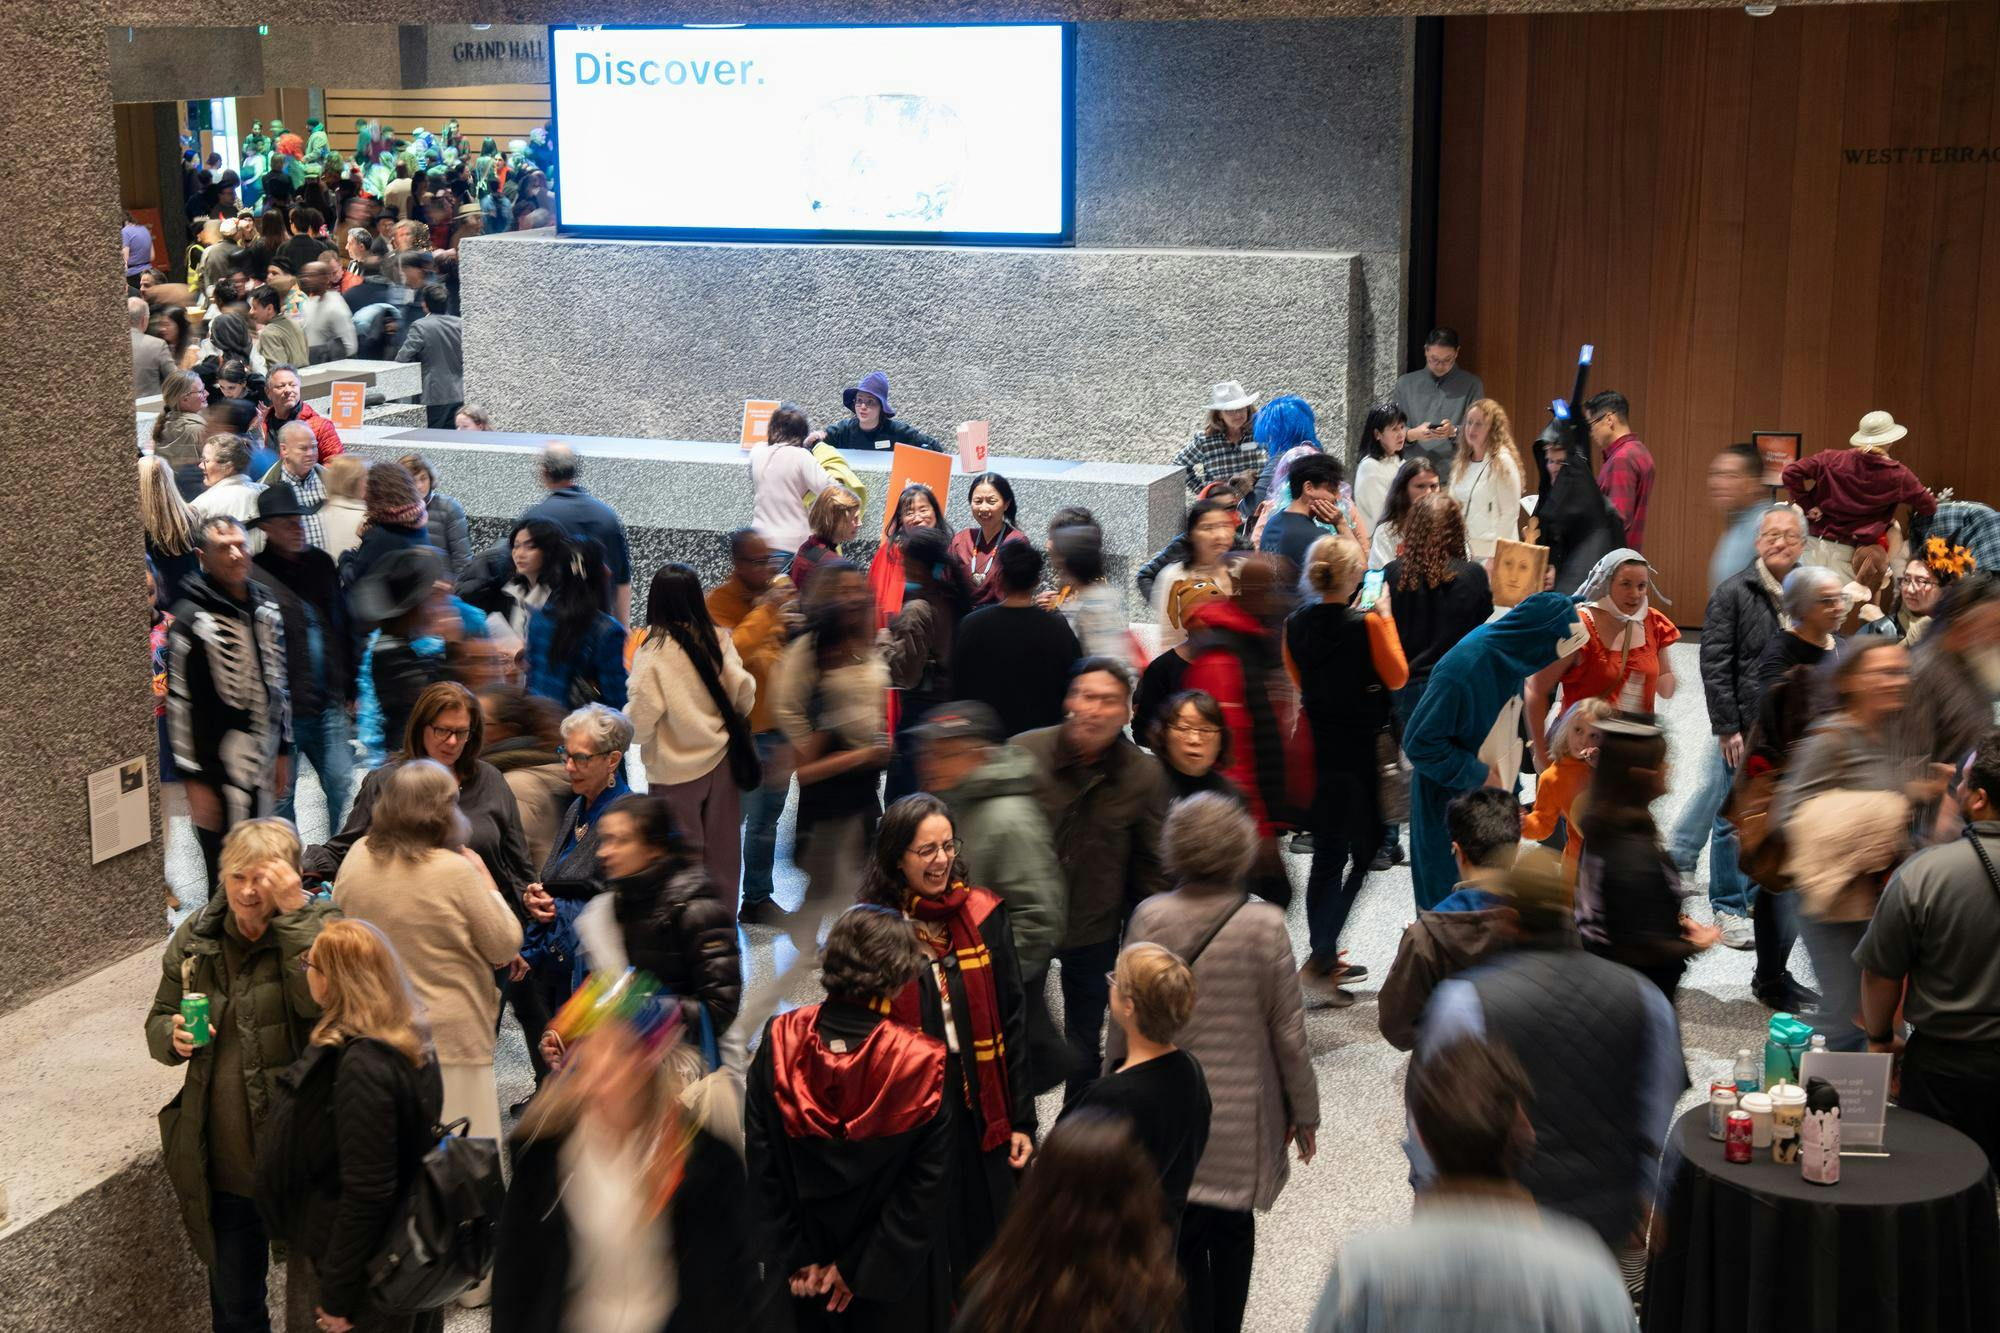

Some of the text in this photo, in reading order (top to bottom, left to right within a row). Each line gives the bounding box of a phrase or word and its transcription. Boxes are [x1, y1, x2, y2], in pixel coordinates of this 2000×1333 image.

[453, 40, 543, 62] GRAND HALL
[575, 52, 763, 86] Discover.
[1844, 148, 1906, 163] WEST
